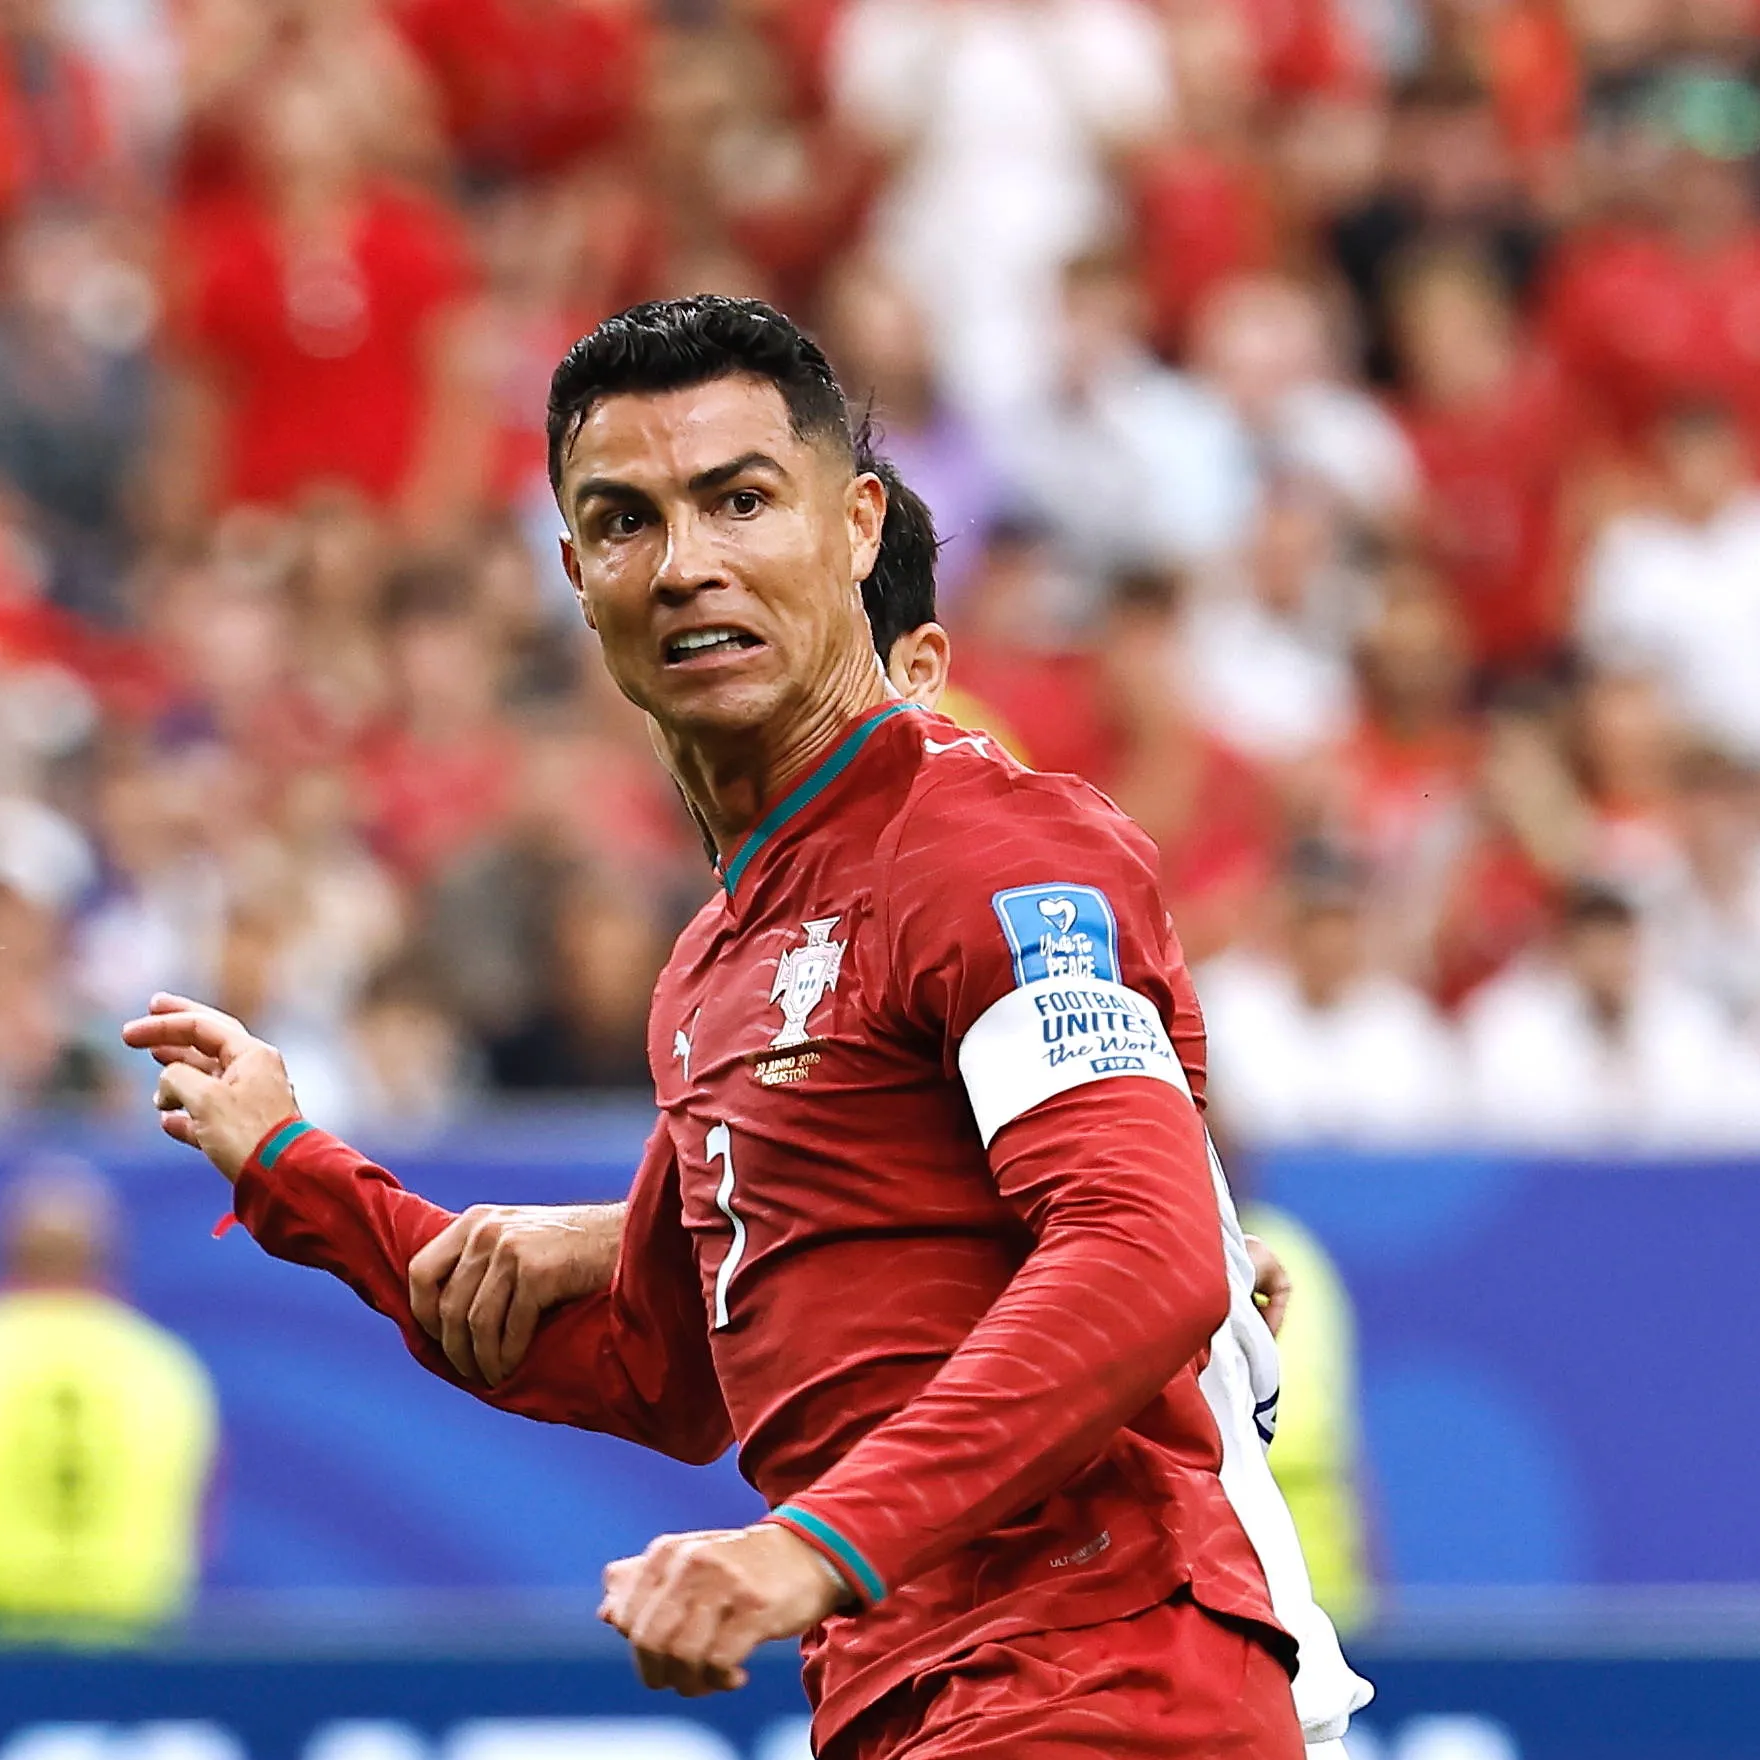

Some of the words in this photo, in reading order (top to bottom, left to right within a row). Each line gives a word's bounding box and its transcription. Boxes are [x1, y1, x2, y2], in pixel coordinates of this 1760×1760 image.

[1046, 955, 1097, 979] PEACE
[1043, 1011, 1158, 1043] UNITES
[1041, 1043, 1094, 1067] the
[1090, 1057, 1145, 1073] FIFA
[761, 1065, 809, 1086] HOUSTON
[706, 1119, 747, 1329] 7
